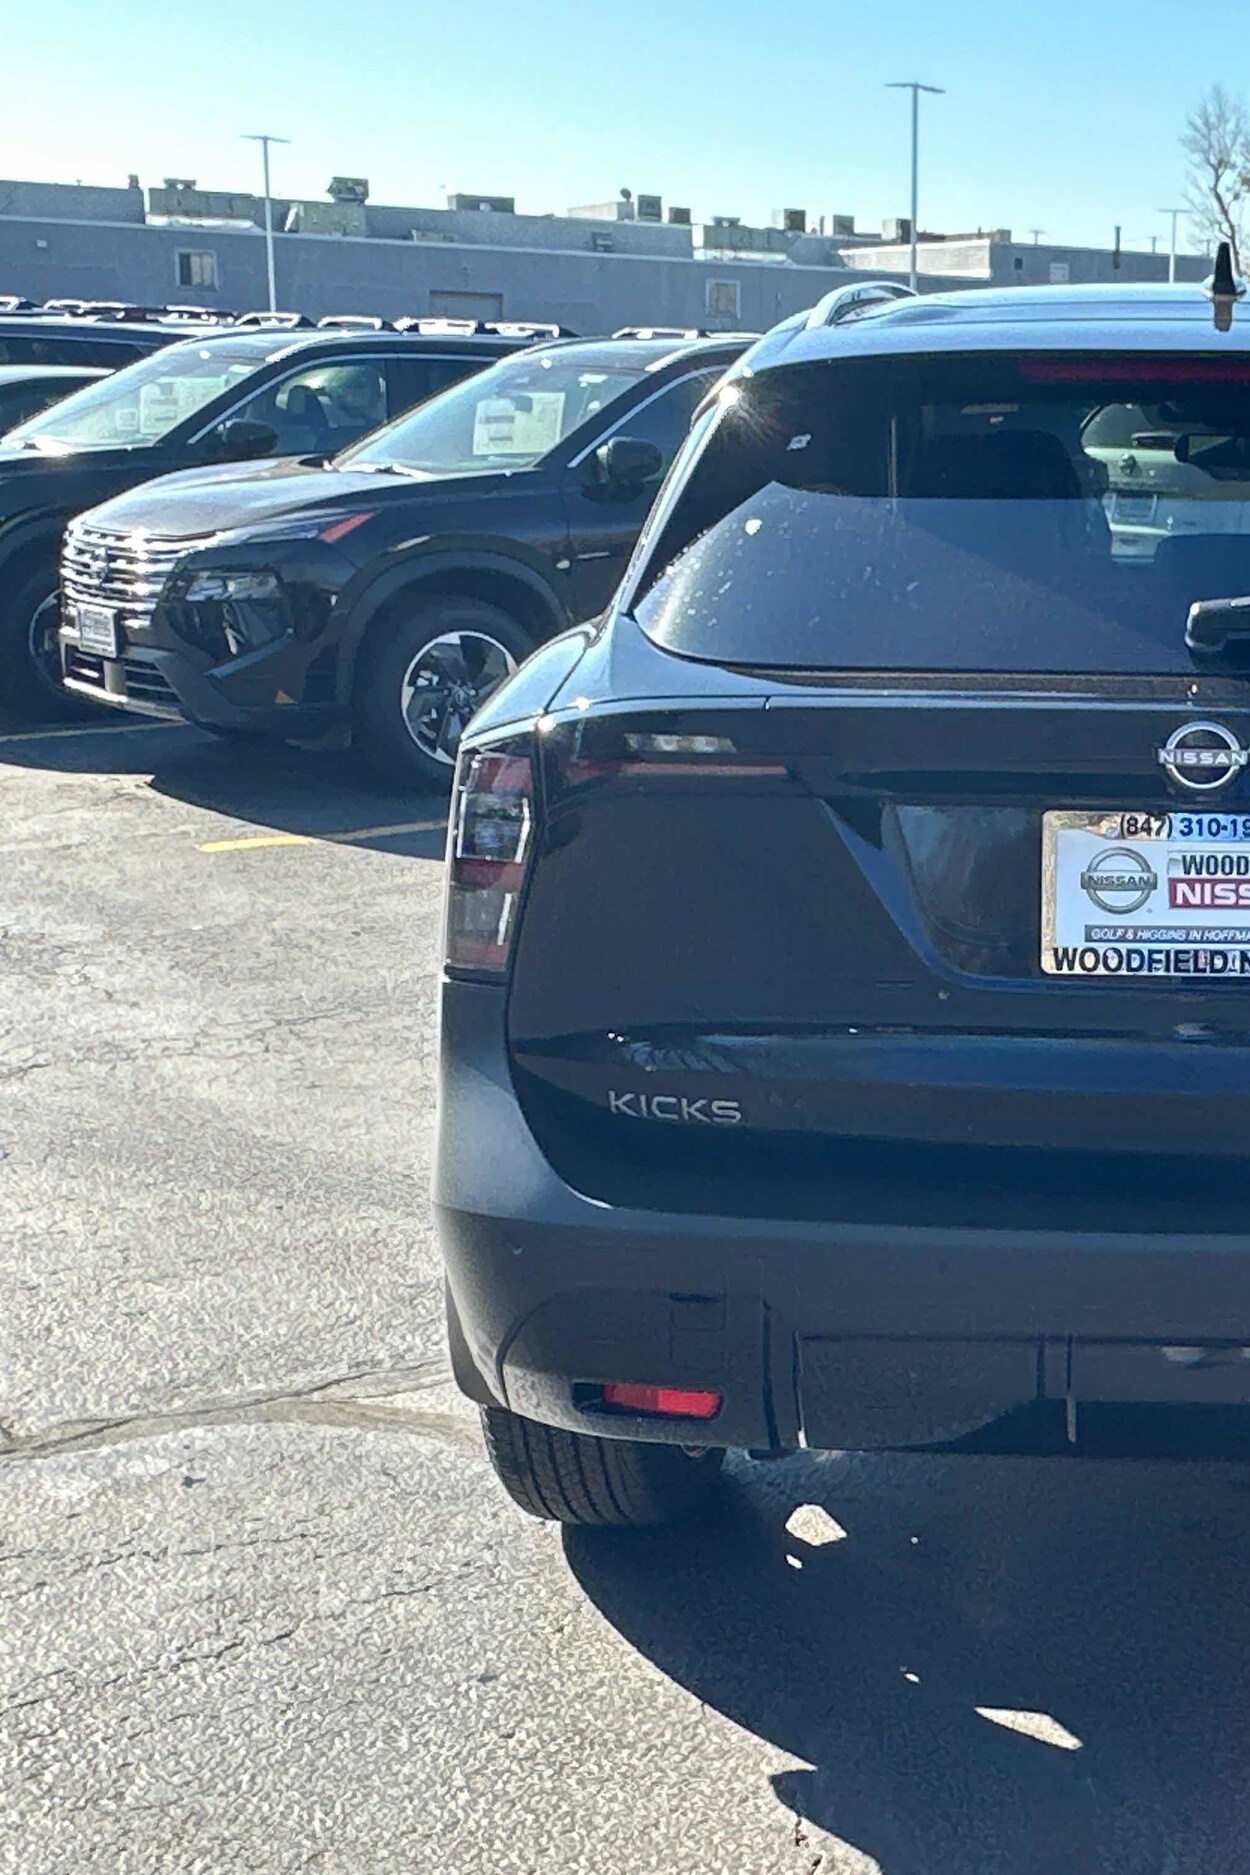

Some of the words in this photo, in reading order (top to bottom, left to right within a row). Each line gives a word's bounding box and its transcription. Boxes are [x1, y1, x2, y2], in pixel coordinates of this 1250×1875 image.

[1159, 751, 1247, 765] NISSAN
[1119, 814, 1173, 838] (847)
[1088, 875, 1151, 888] NISSAN
[1091, 928, 1123, 940] GOLF
[1125, 928, 1134, 940] &
[1189, 929, 1201, 941] IN
[1053, 947, 1229, 973] WOODFIELD
[608, 1089, 742, 1124] KICKS
